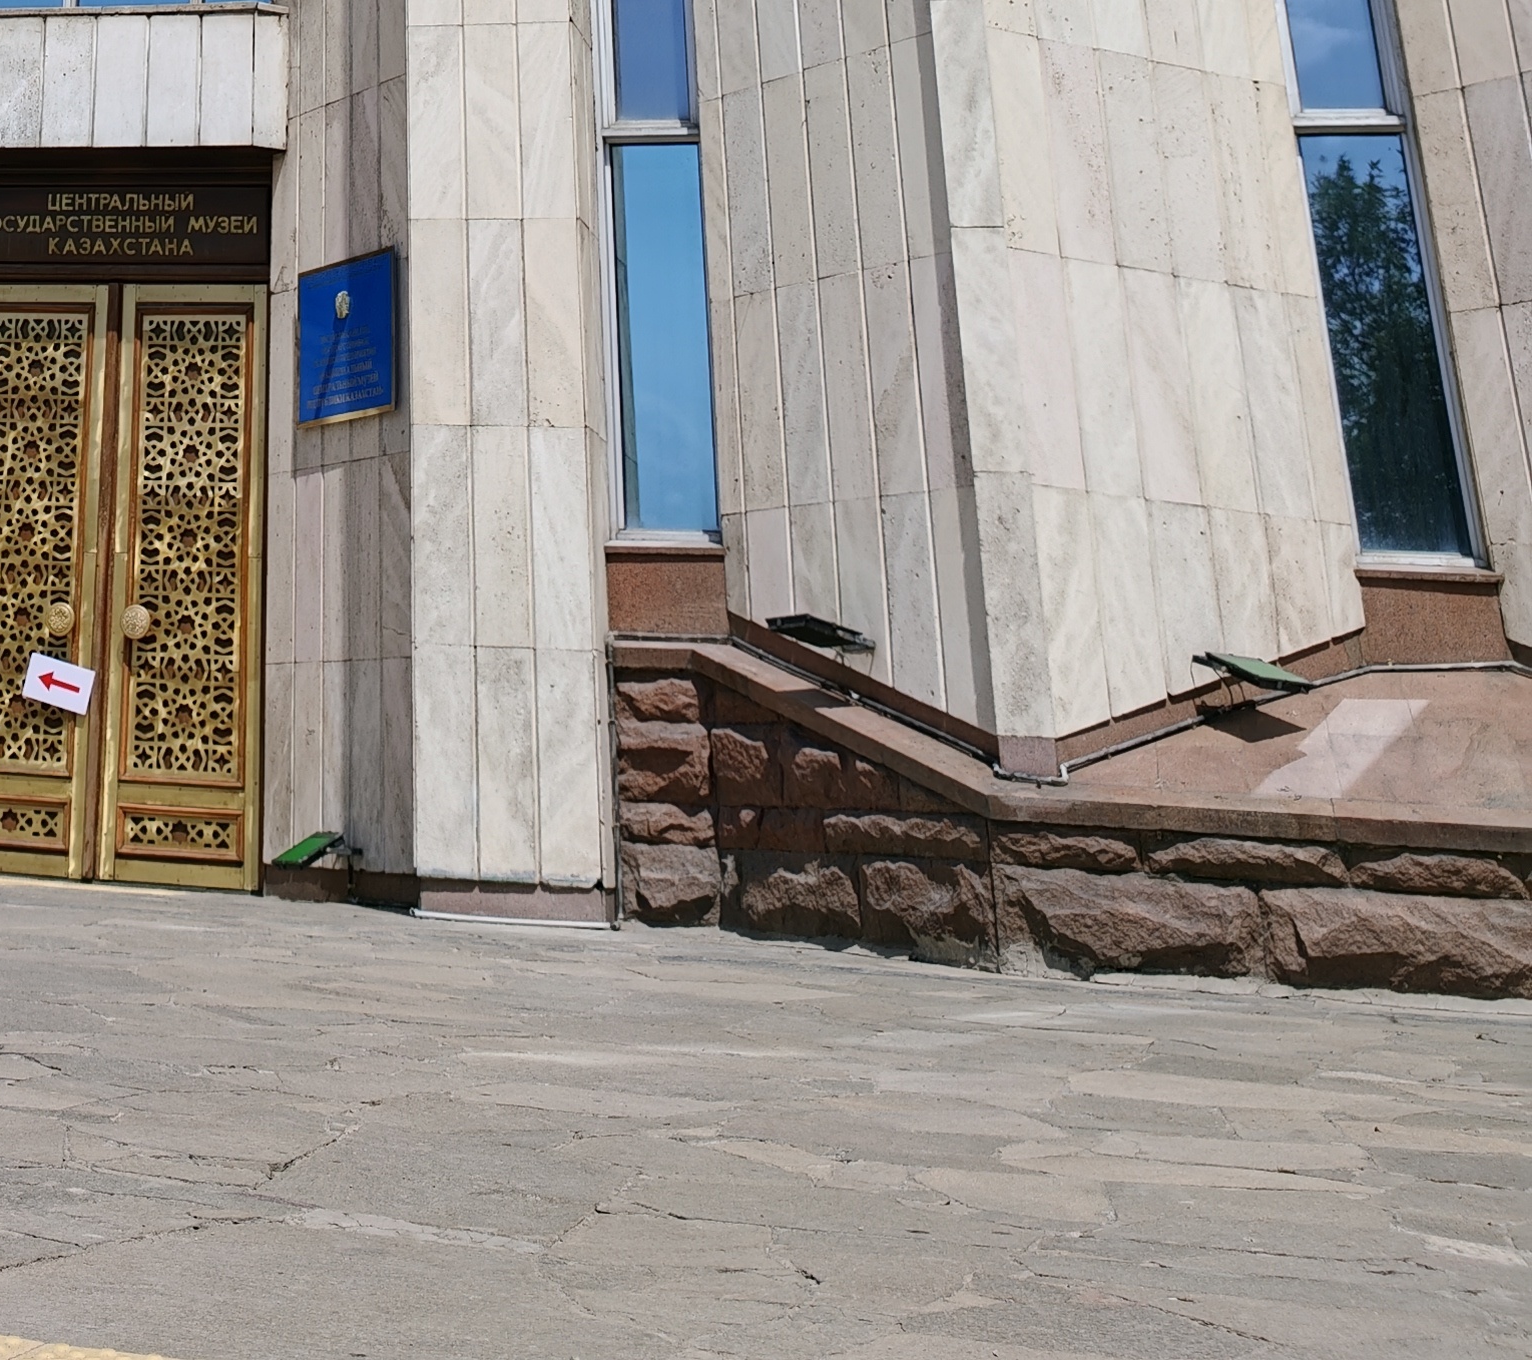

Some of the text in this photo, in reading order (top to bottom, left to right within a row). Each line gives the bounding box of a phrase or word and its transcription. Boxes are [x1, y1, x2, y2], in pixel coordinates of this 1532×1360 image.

[47, 191, 194, 211] ЦЕНТРАЛЬНЫЙ
[187, 214, 258, 234] МУЗЕЙ
[48, 237, 194, 256] КАЗАХСТАНА
